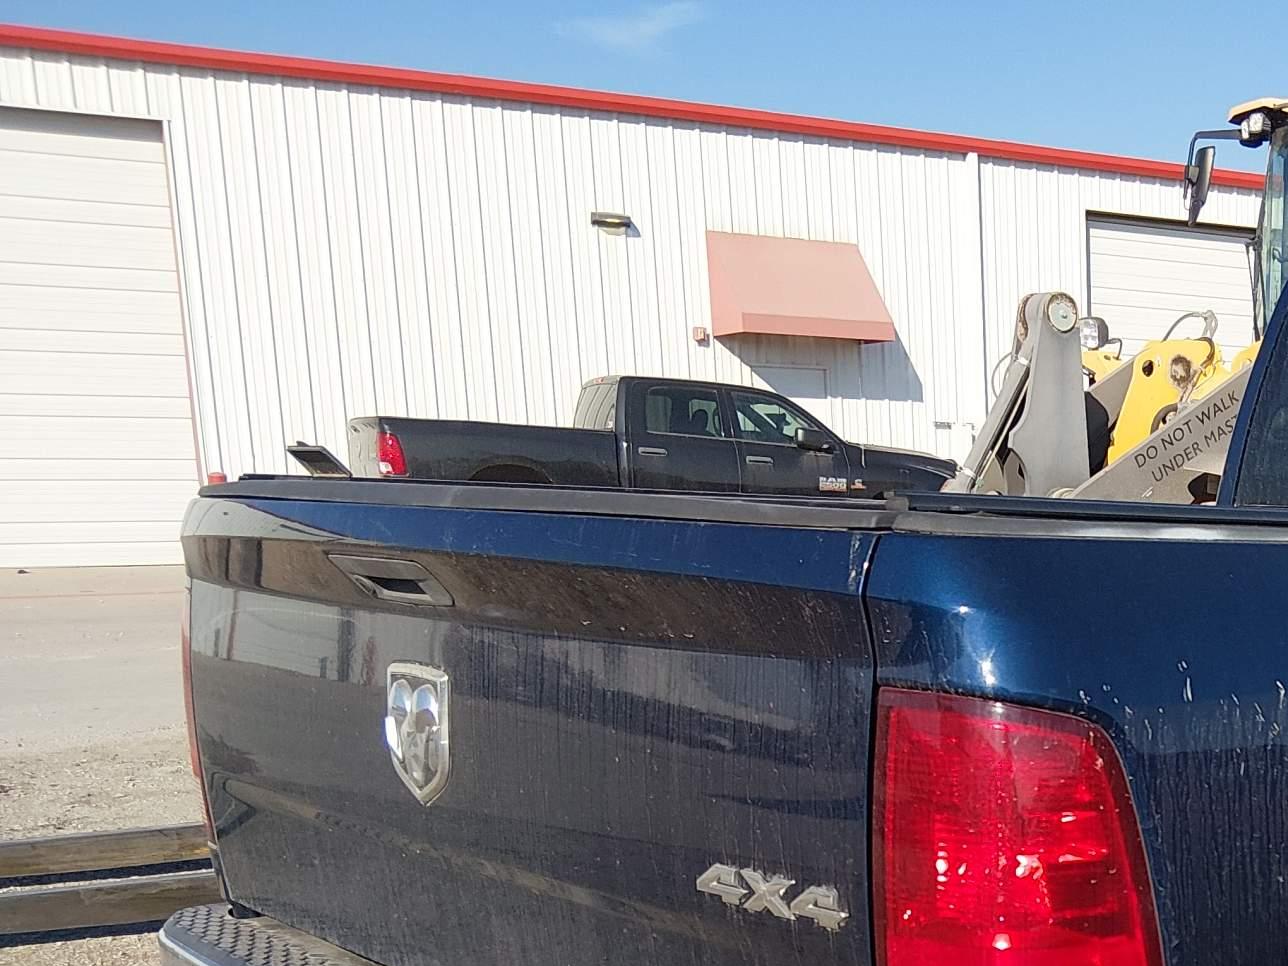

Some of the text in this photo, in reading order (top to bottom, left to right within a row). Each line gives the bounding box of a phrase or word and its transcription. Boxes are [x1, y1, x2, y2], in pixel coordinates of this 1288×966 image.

[1134, 390, 1239, 468] DO NOT WALK
[1152, 442, 1203, 482] UNDER
